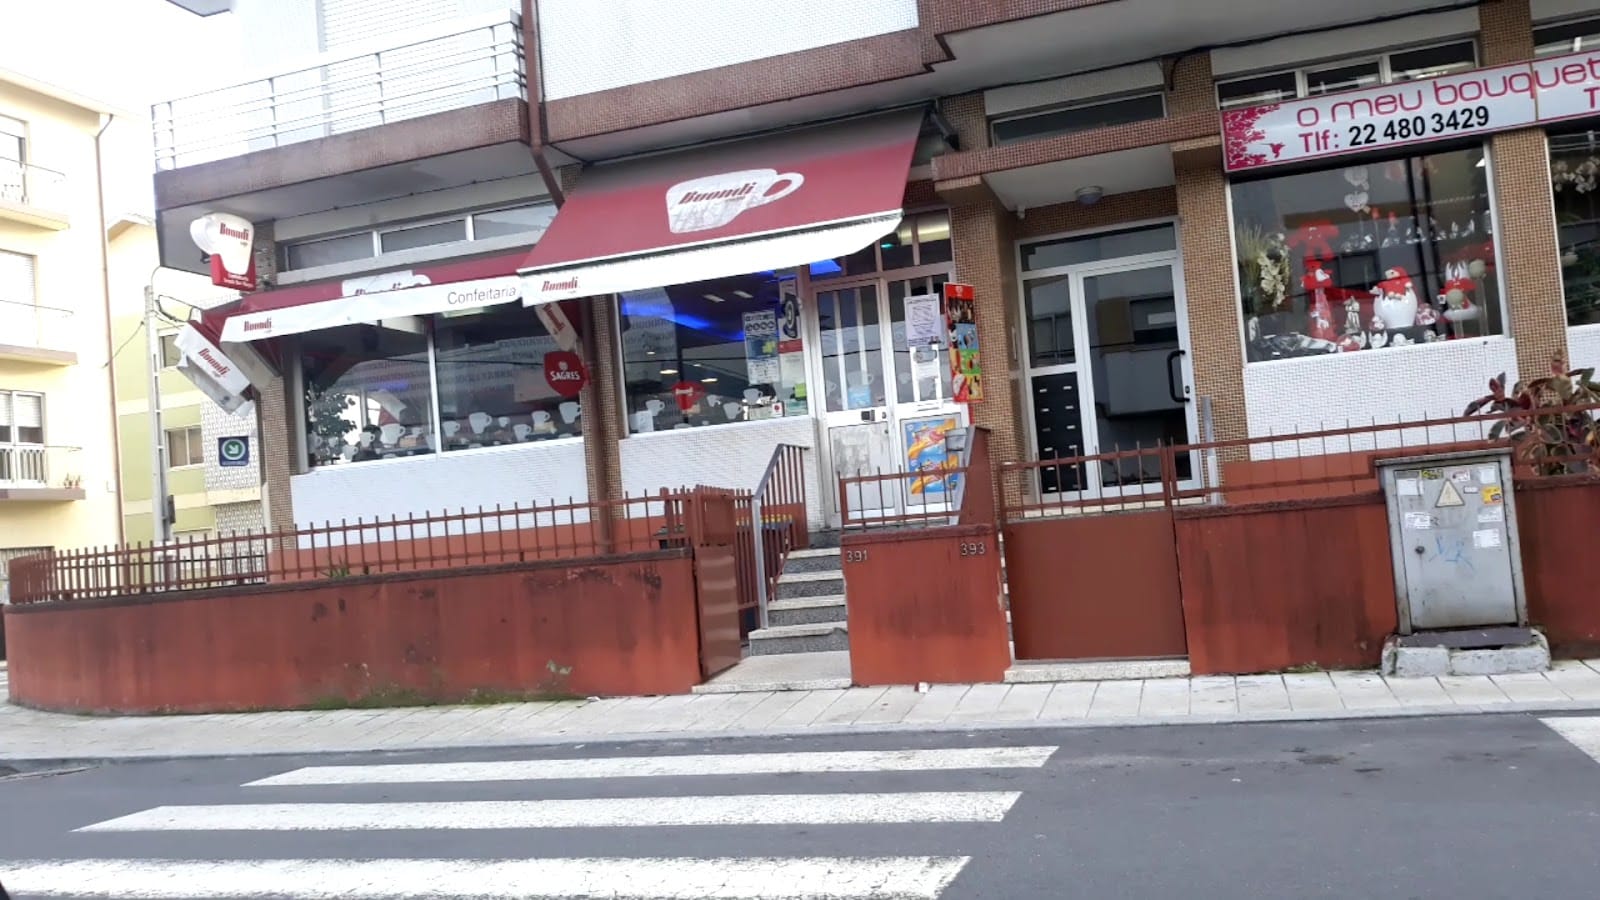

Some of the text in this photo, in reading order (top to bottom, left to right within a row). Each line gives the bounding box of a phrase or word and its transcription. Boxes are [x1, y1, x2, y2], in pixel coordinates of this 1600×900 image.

[1331, 90, 1422, 122] meu
[1432, 57, 1600, 106] bouquet
[1299, 106, 1489, 153] Tlf: 22 480 3429
[447, 285, 517, 305] Confeitaria
[550, 370, 580, 382] SAGRES
[846, 549, 868, 563] 391
[960, 542, 986, 556] 393
